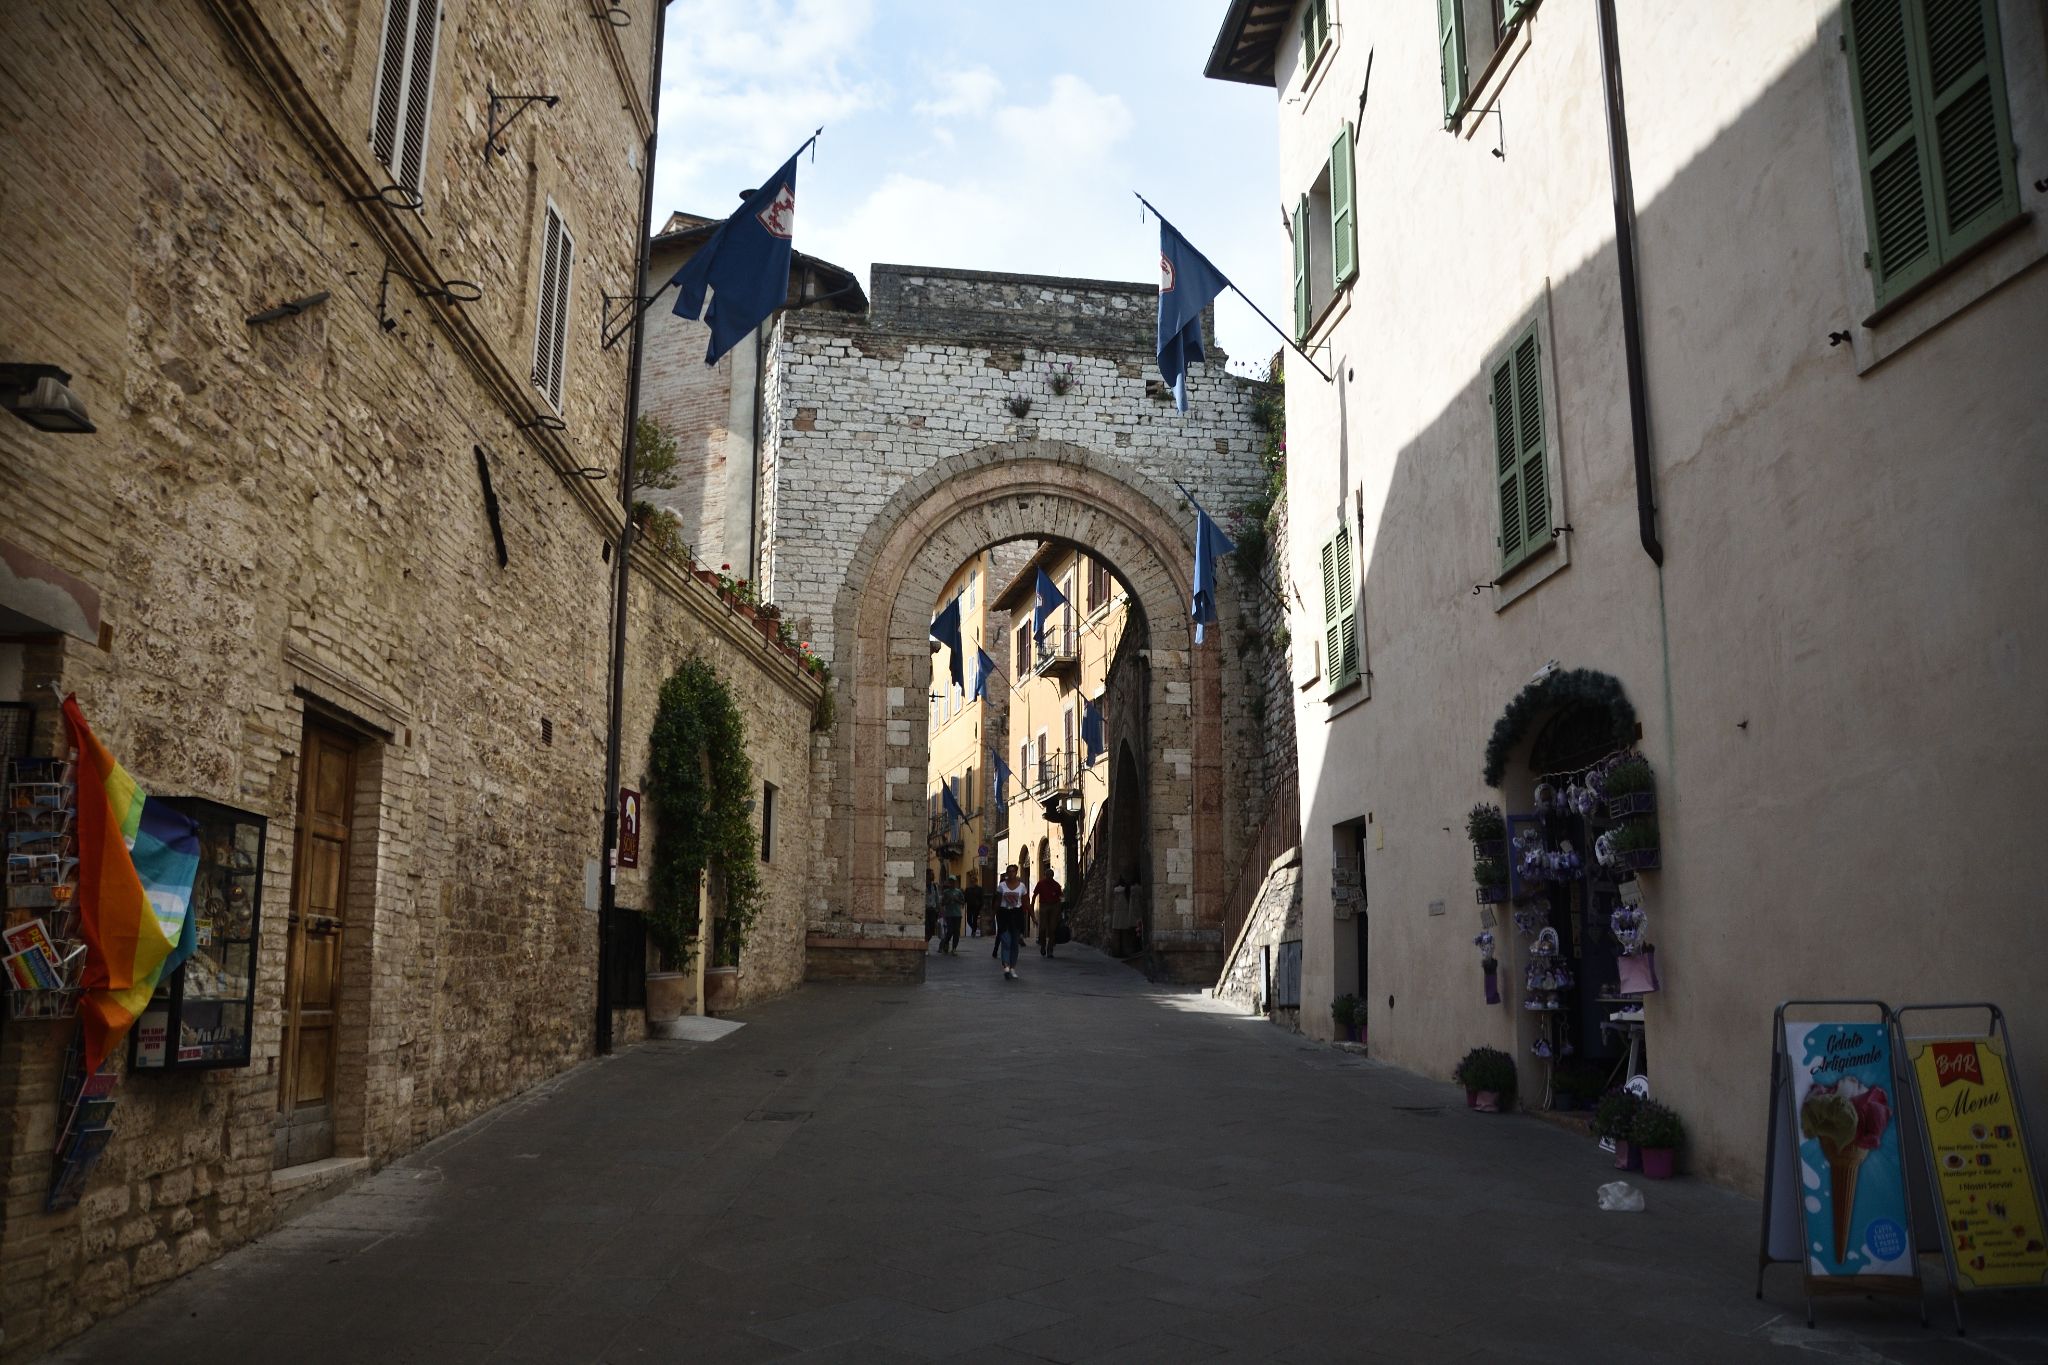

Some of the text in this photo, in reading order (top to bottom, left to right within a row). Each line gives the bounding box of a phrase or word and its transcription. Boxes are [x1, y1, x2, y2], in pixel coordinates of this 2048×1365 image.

[1827, 1032, 1864, 1054] Gelato
[1810, 1045, 1882, 1075] Artigianale
[1936, 1053, 1978, 1075] BAR
[1935, 1087, 2000, 1123] Menu
